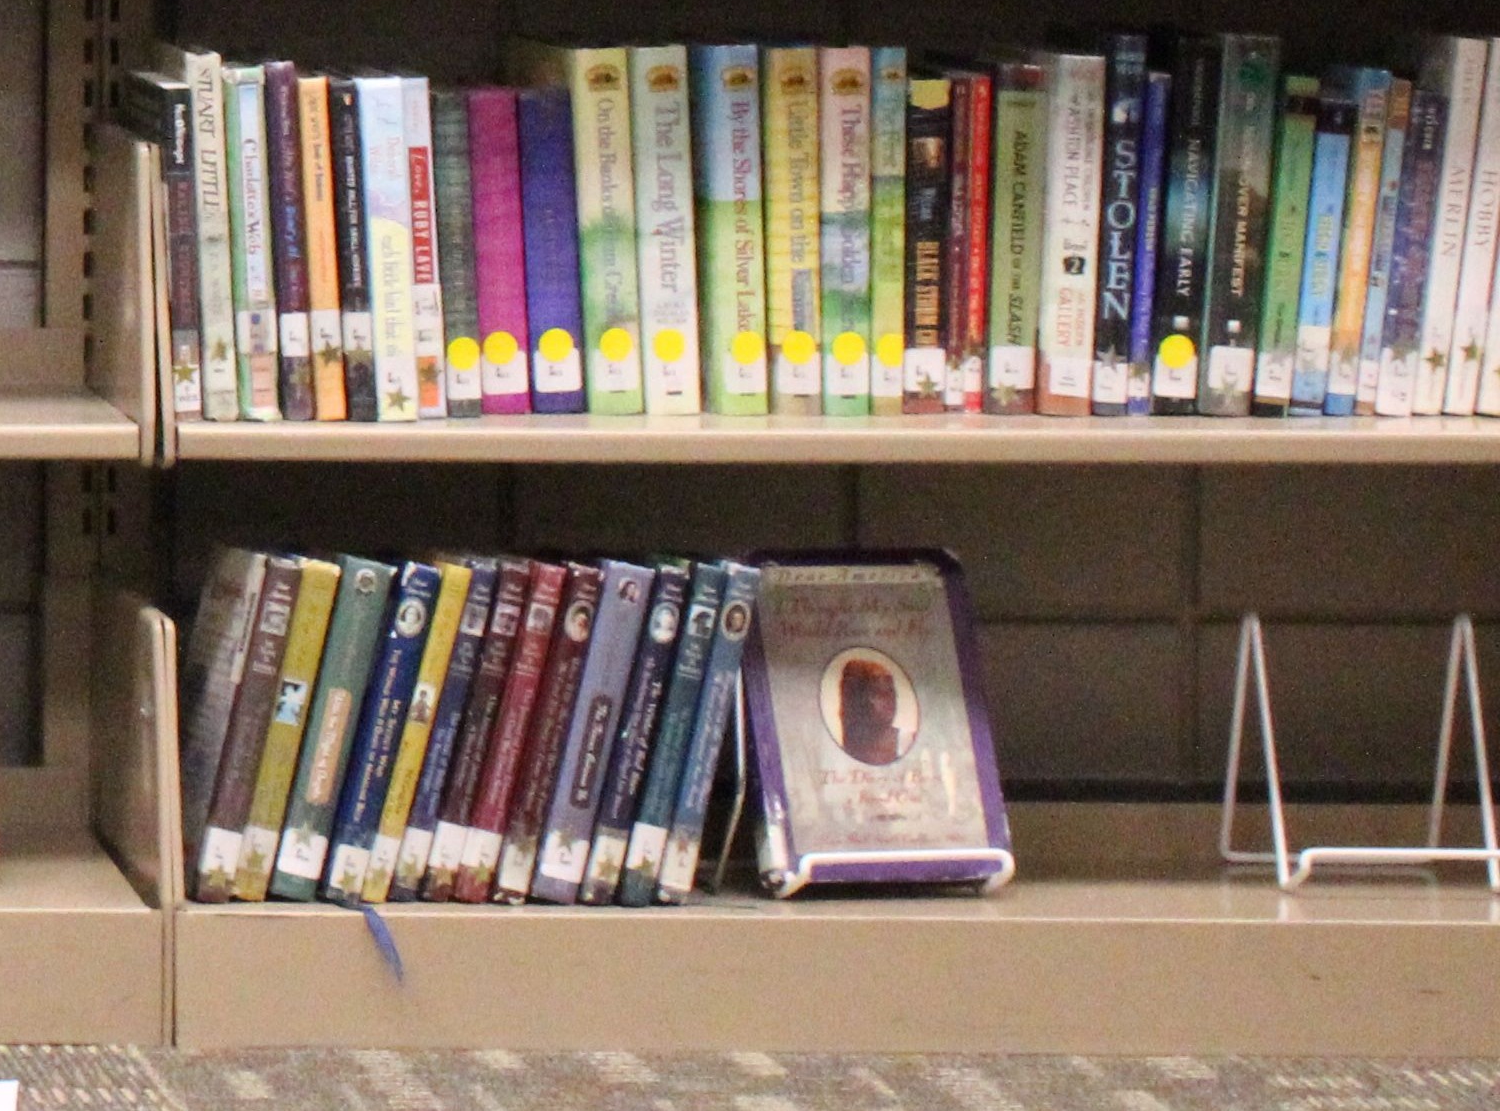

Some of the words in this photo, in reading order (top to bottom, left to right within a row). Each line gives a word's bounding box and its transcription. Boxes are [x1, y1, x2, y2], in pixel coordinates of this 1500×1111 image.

[200, 69, 217, 137] STUART
[655, 103, 682, 147] The
[730, 101, 747, 124] By
[733, 127, 749, 152] the
[1011, 131, 1028, 175] ADAM
[201, 149, 220, 211] LITTLE
[243, 138, 258, 220] Charlotte's
[651, 152, 681, 211] Long
[733, 156, 751, 214] Shores
[246, 221, 261, 254] Web
[736, 220, 752, 235] of
[1009, 182, 1028, 254] CANFIELD
[1103, 140, 1136, 321] STOLEN
[656, 220, 686, 292] Winter
[736, 239, 753, 284] Silver
[737, 290, 754, 331] Lake
